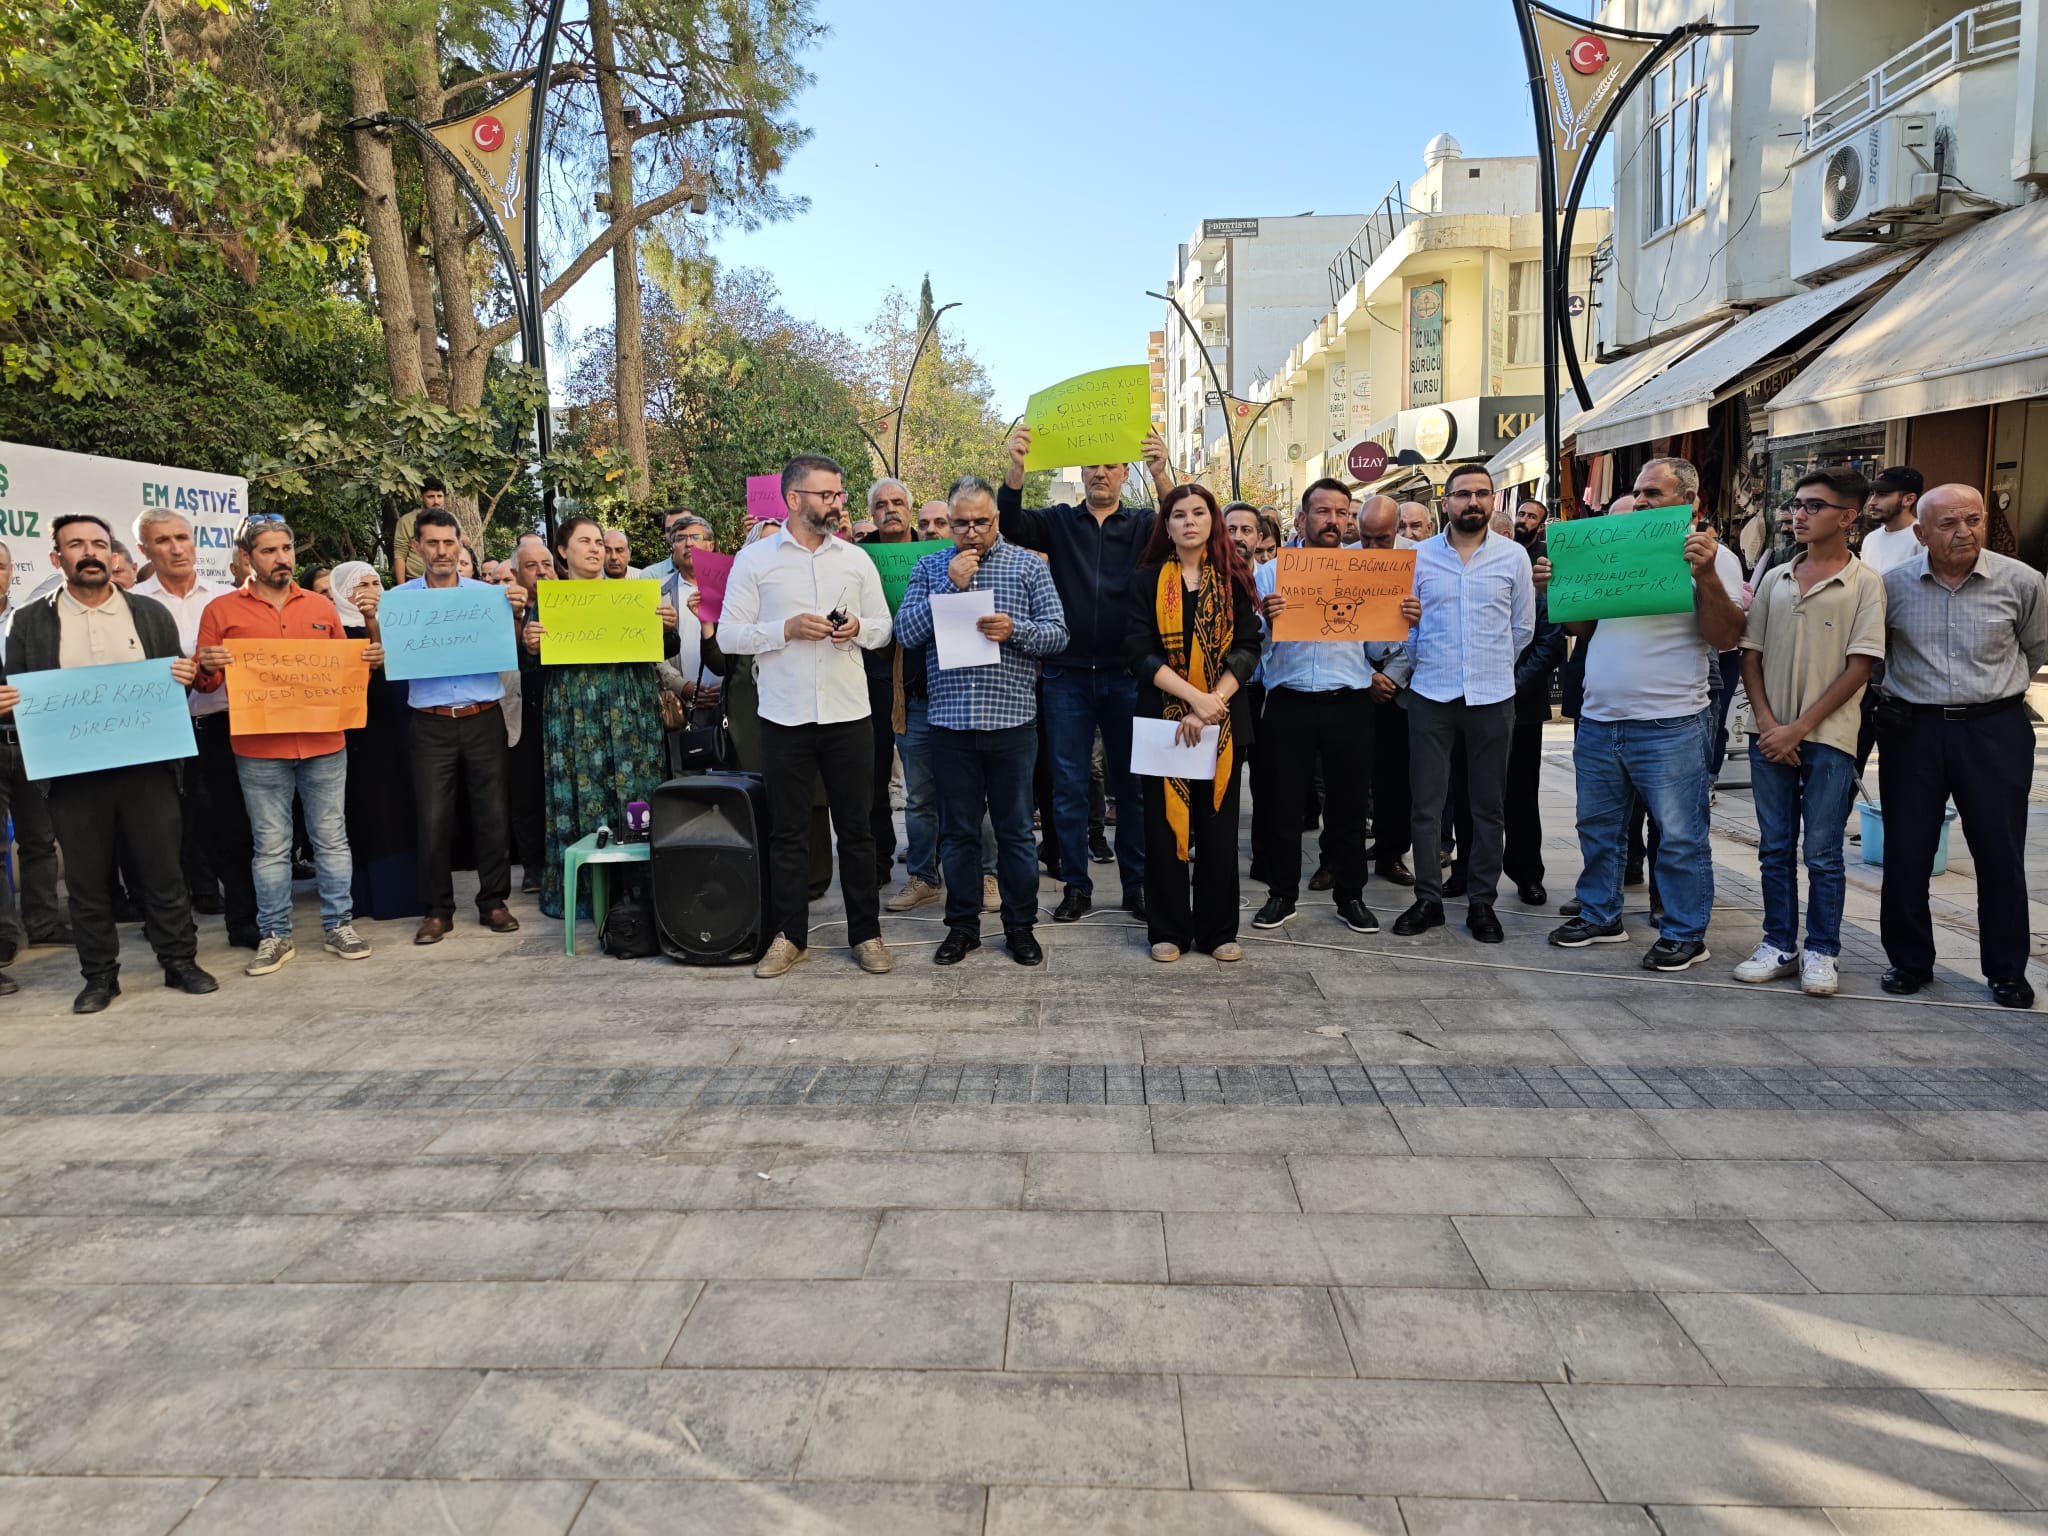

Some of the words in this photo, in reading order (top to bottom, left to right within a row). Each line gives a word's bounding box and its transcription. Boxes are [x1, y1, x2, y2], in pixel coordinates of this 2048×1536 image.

[1868, 128, 1880, 185] arçelik
[1411, 354, 1441, 374] SÜRÜCÜ
[1117, 377, 1145, 389] XWE
[1413, 378, 1439, 394] KURSU
[1067, 432, 1115, 449] NEKIN
[1351, 455, 1385, 469] LİZAY
[142, 482, 169, 508] EM
[175, 486, 241, 516] AŞTIYÊ
[1597, 552, 1619, 565] VE
[1281, 585, 1323, 597] MADDE
[544, 591, 601, 609] UMUT
[611, 592, 646, 609] VAR
[113, 681, 172, 703] KARŞI
[69, 708, 153, 741] DİRENİŞ
